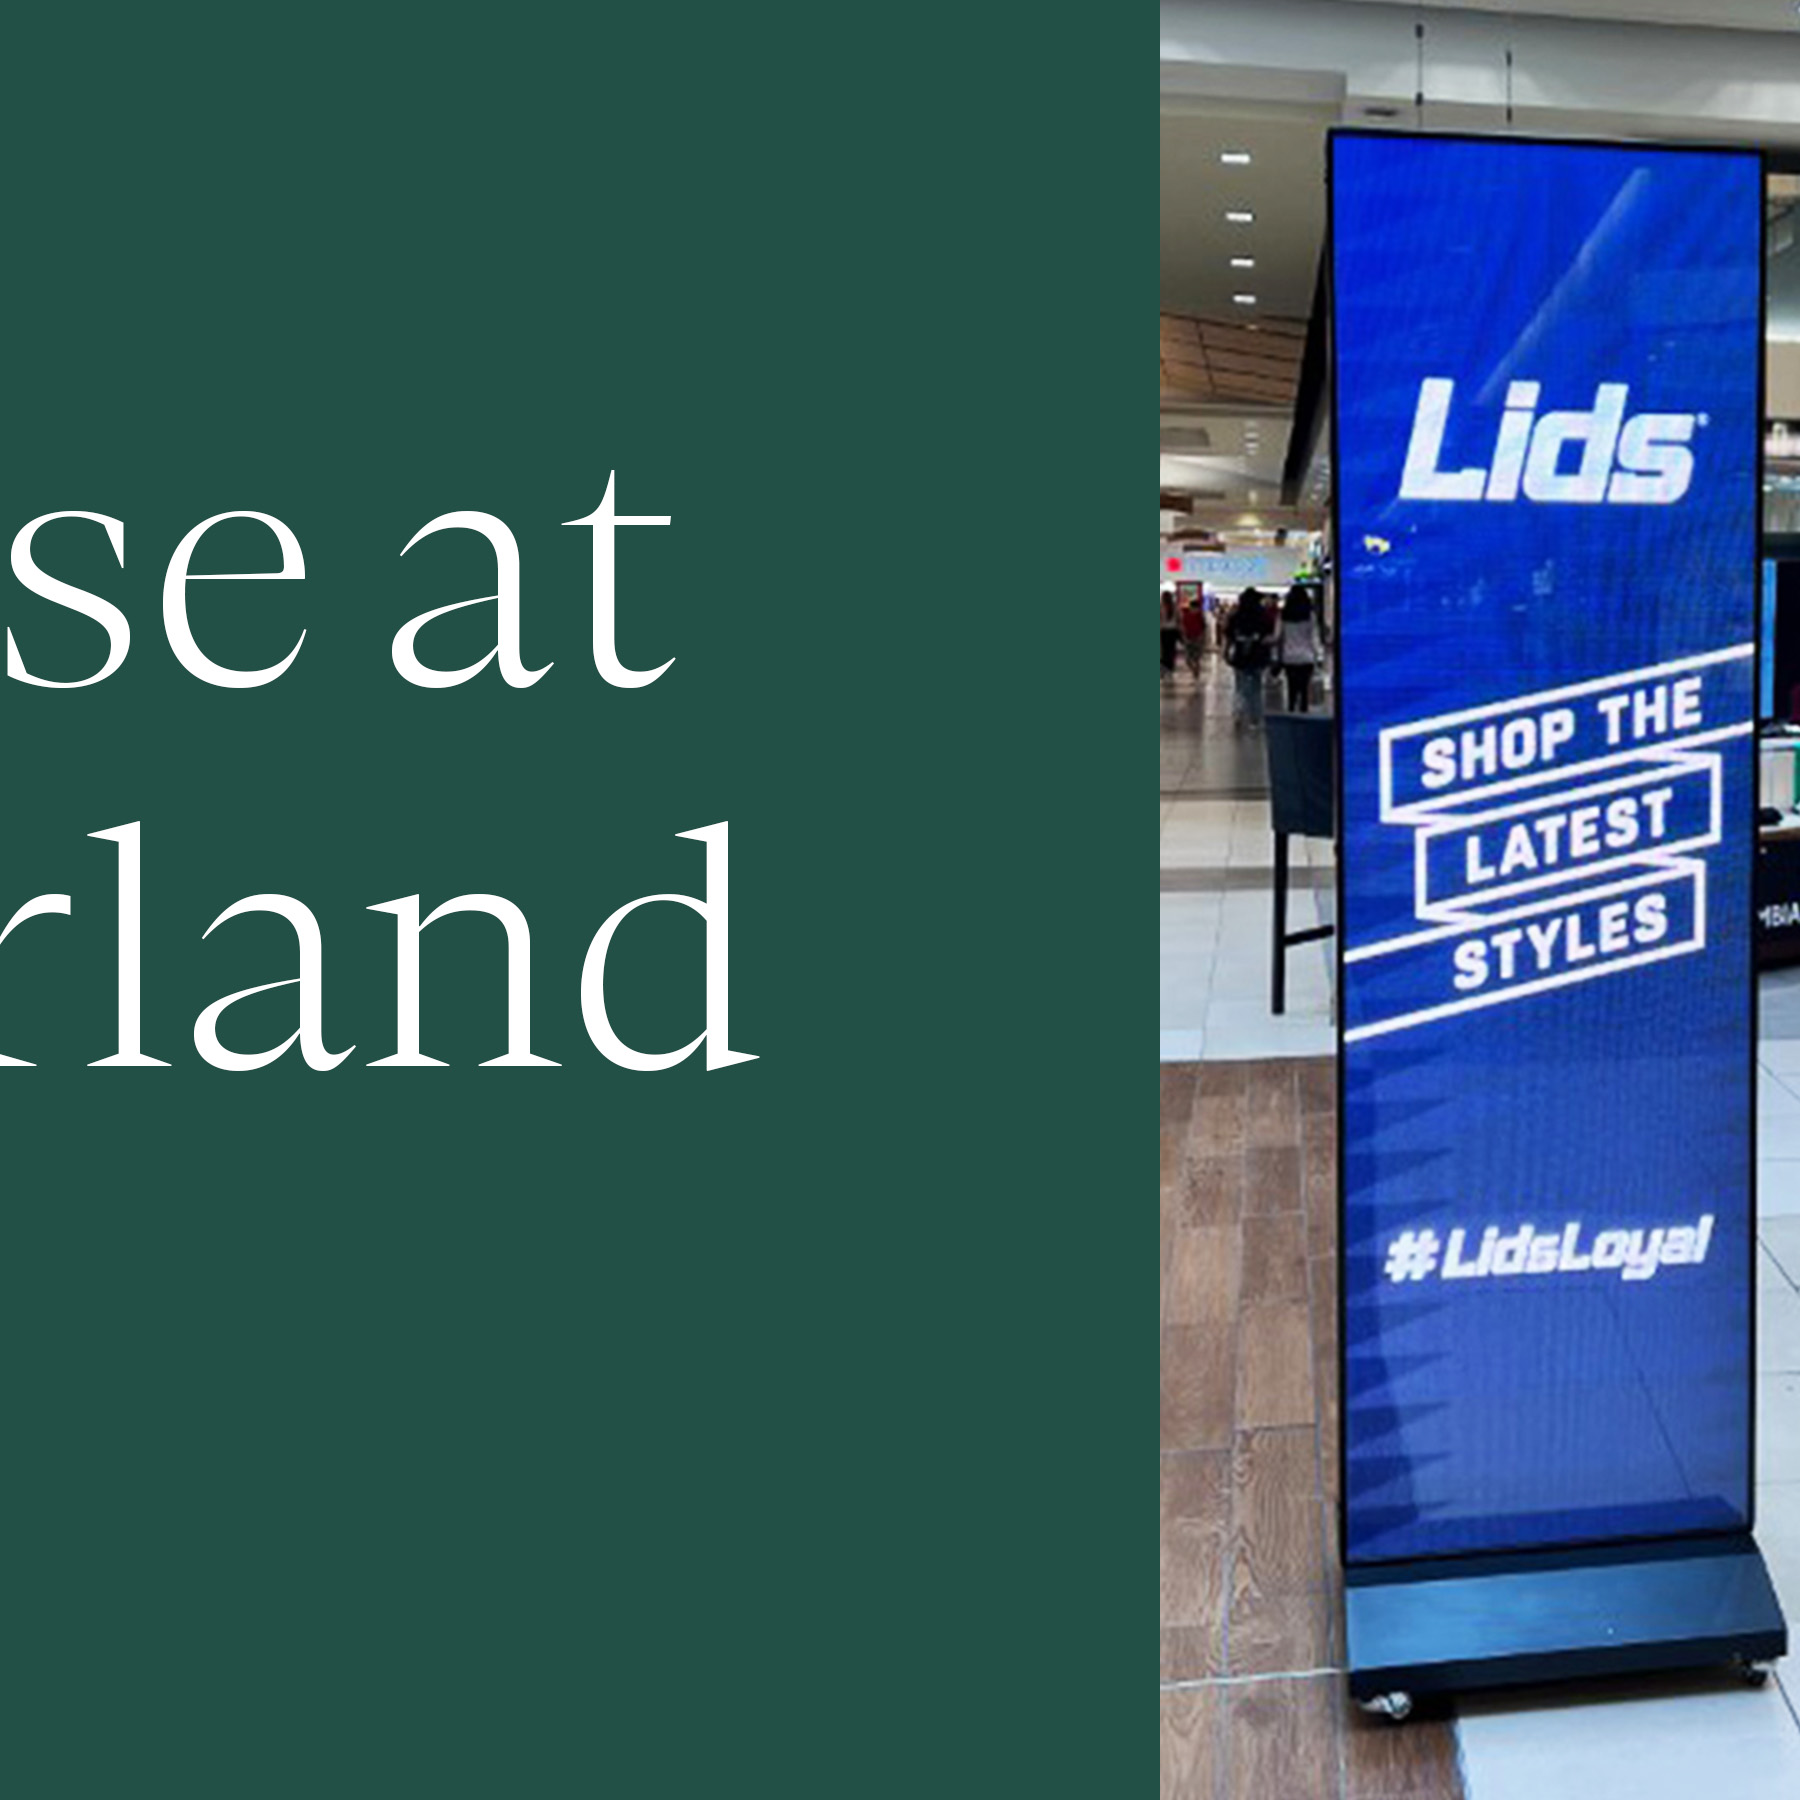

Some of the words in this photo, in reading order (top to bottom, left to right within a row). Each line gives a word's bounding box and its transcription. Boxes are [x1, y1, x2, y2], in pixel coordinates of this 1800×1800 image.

[1399, 377, 1699, 503] Lids
[1420, 706, 1575, 789] SHOP
[1598, 676, 1702, 746] THE
[1466, 787, 1673, 884] LATEST
[1452, 894, 1668, 990] STYLES
[1384, 1214, 1715, 1281] #LidsLoyal
